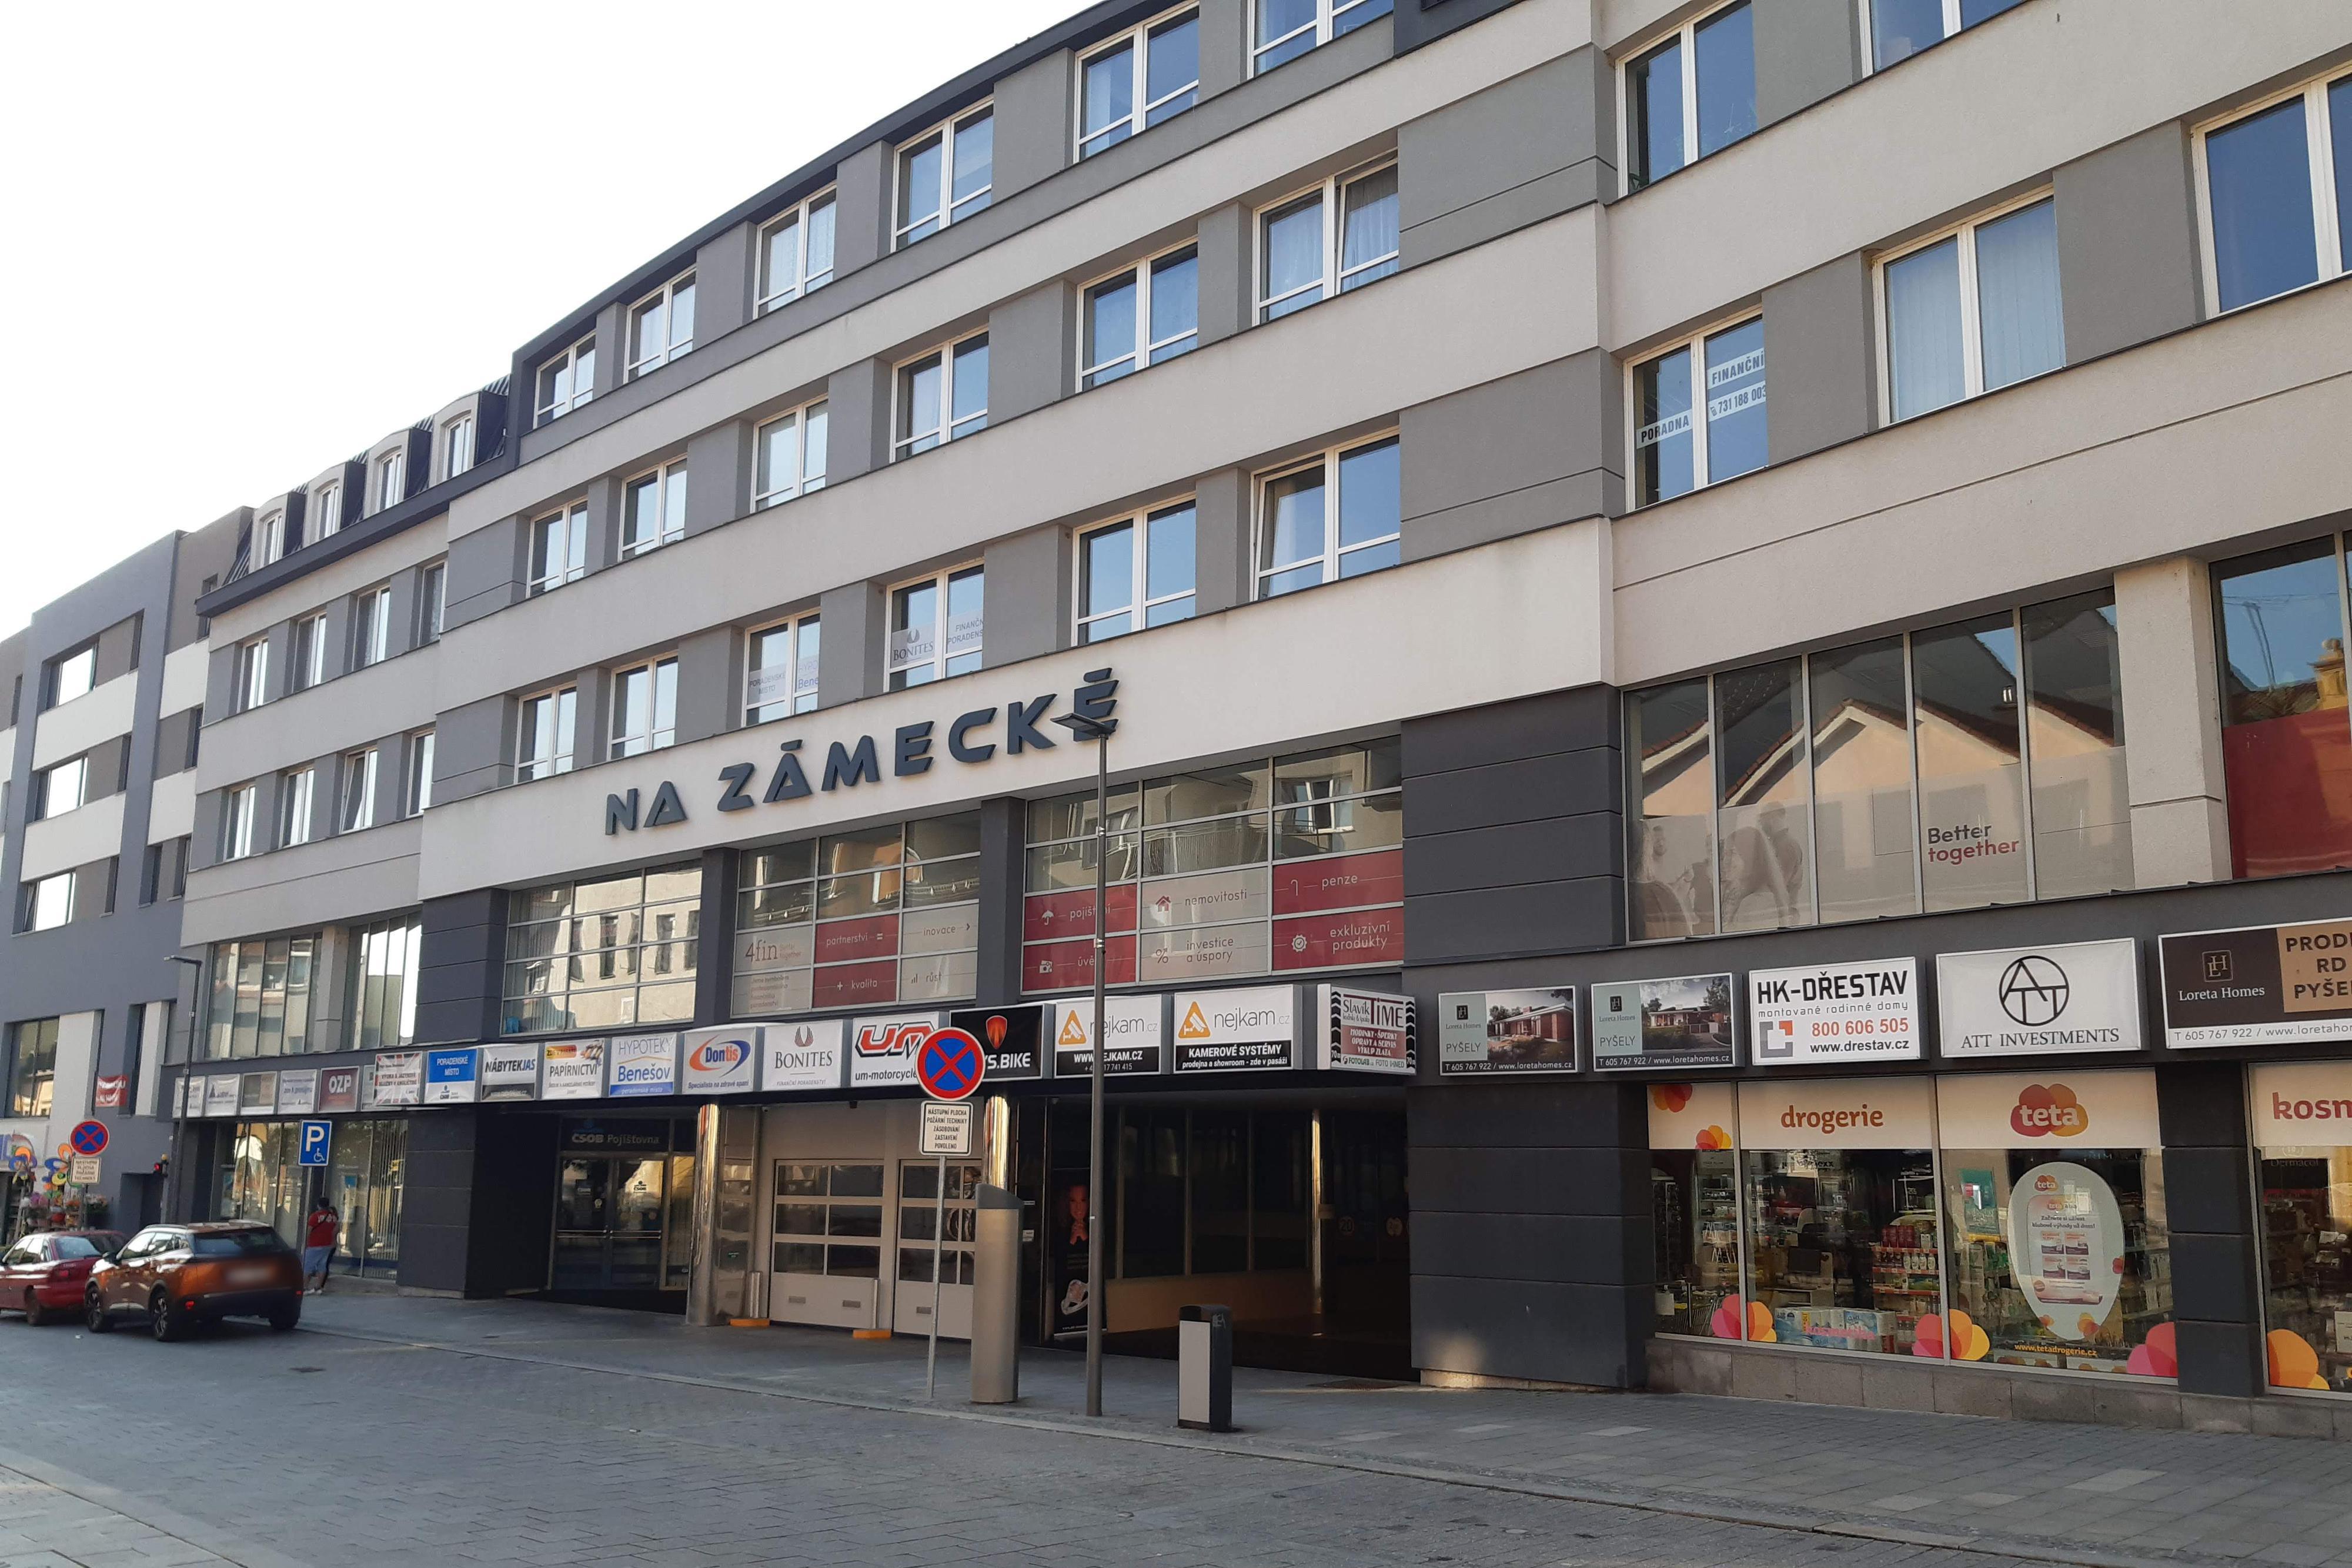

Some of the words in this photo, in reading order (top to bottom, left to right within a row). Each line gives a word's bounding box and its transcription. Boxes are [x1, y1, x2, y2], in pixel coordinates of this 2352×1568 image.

[1712, 350, 1764, 385] FINANČNÍ
[1718, 397, 1732, 414] 731
[1734, 392, 1749, 409] 188
[1641, 414, 1690, 443] PORADNA
[893, 641, 934, 661] BONITES
[604, 780, 687, 836] NA
[717, 667, 1120, 813] ZÁMECKÉ
[1927, 824, 1992, 844] Better
[1927, 839, 2019, 865] together
[1322, 875, 1358, 891] penze
[1184, 888, 1248, 907] nemovitosti
[923, 925, 956, 937] inovace
[1329, 921, 1391, 938] exkluzivní
[746, 938, 778, 962] 4fin
[1187, 938, 1234, 951] investice
[1332, 935, 1388, 954] produkty
[1196, 950, 1233, 965] úspory
[2317, 957, 2347, 974] RD
[851, 979, 878, 990] kvalita
[1757, 971, 1908, 1004] HK-DŘESTAV
[2294, 978, 2352, 999] PYŠE
[2178, 989, 2218, 1001] Loreta
[2221, 986, 2266, 998] Homes
[1343, 999, 1370, 1015] Slavík
[1758, 1005, 1820, 1018] montované
[1826, 1002, 1872, 1014] rodinné
[1877, 1001, 1908, 1011] domy
[1214, 1007, 1290, 1031] nejkam.cz
[1812, 1021, 1840, 1037] 800
[1845, 1019, 1874, 1035] 606
[1879, 1017, 1909, 1034] 505
[1600, 1034, 1635, 1047] PYŠELY
[1960, 1034, 1992, 1049] ATT
[2000, 1028, 2120, 1047] INVESTMENTS
[2174, 1032, 2181, 1041] T
[2185, 1031, 2204, 1041] 605
[2209, 1029, 2227, 1039] 767
[2231, 1028, 2252, 1038] 922
[705, 1045, 739, 1063] Dontis
[1189, 1044, 1237, 1058] KAMEROVÉ
[1239, 1043, 1282, 1056] SYSTÉMY
[1446, 1041, 1481, 1053] PYŠELY
[1810, 1039, 1910, 1054] www.drestav.cz
[774, 1050, 833, 1069] BONITES
[985, 1052, 1031, 1069] S.BIKE
[1074, 1051, 1143, 1063] WWWEJKAM.CZ
[1182, 1060, 1207, 1069] prodejna
[1214, 1059, 1245, 1067] showroom
[1633, 1057, 1646, 1065] 922
[1653, 1054, 1729, 1064] www.loretahomes.cz
[618, 1063, 670, 1082] Benešov
[1122, 1062, 1132, 1071] 415
[1478, 1062, 1491, 1071] 922
[1498, 1061, 1572, 1070] www.loretahomes.cz
[329, 1074, 352, 1094] OZP
[1780, 1103, 1884, 1134] drogerie
[2019, 1104, 2080, 1126] teta
[933, 1124, 960, 1132] ZÁSOBOVÁNÍ
[305, 1125, 325, 1152] P
[2014, 1344, 2098, 1357] www.tetadrogerie.cz
